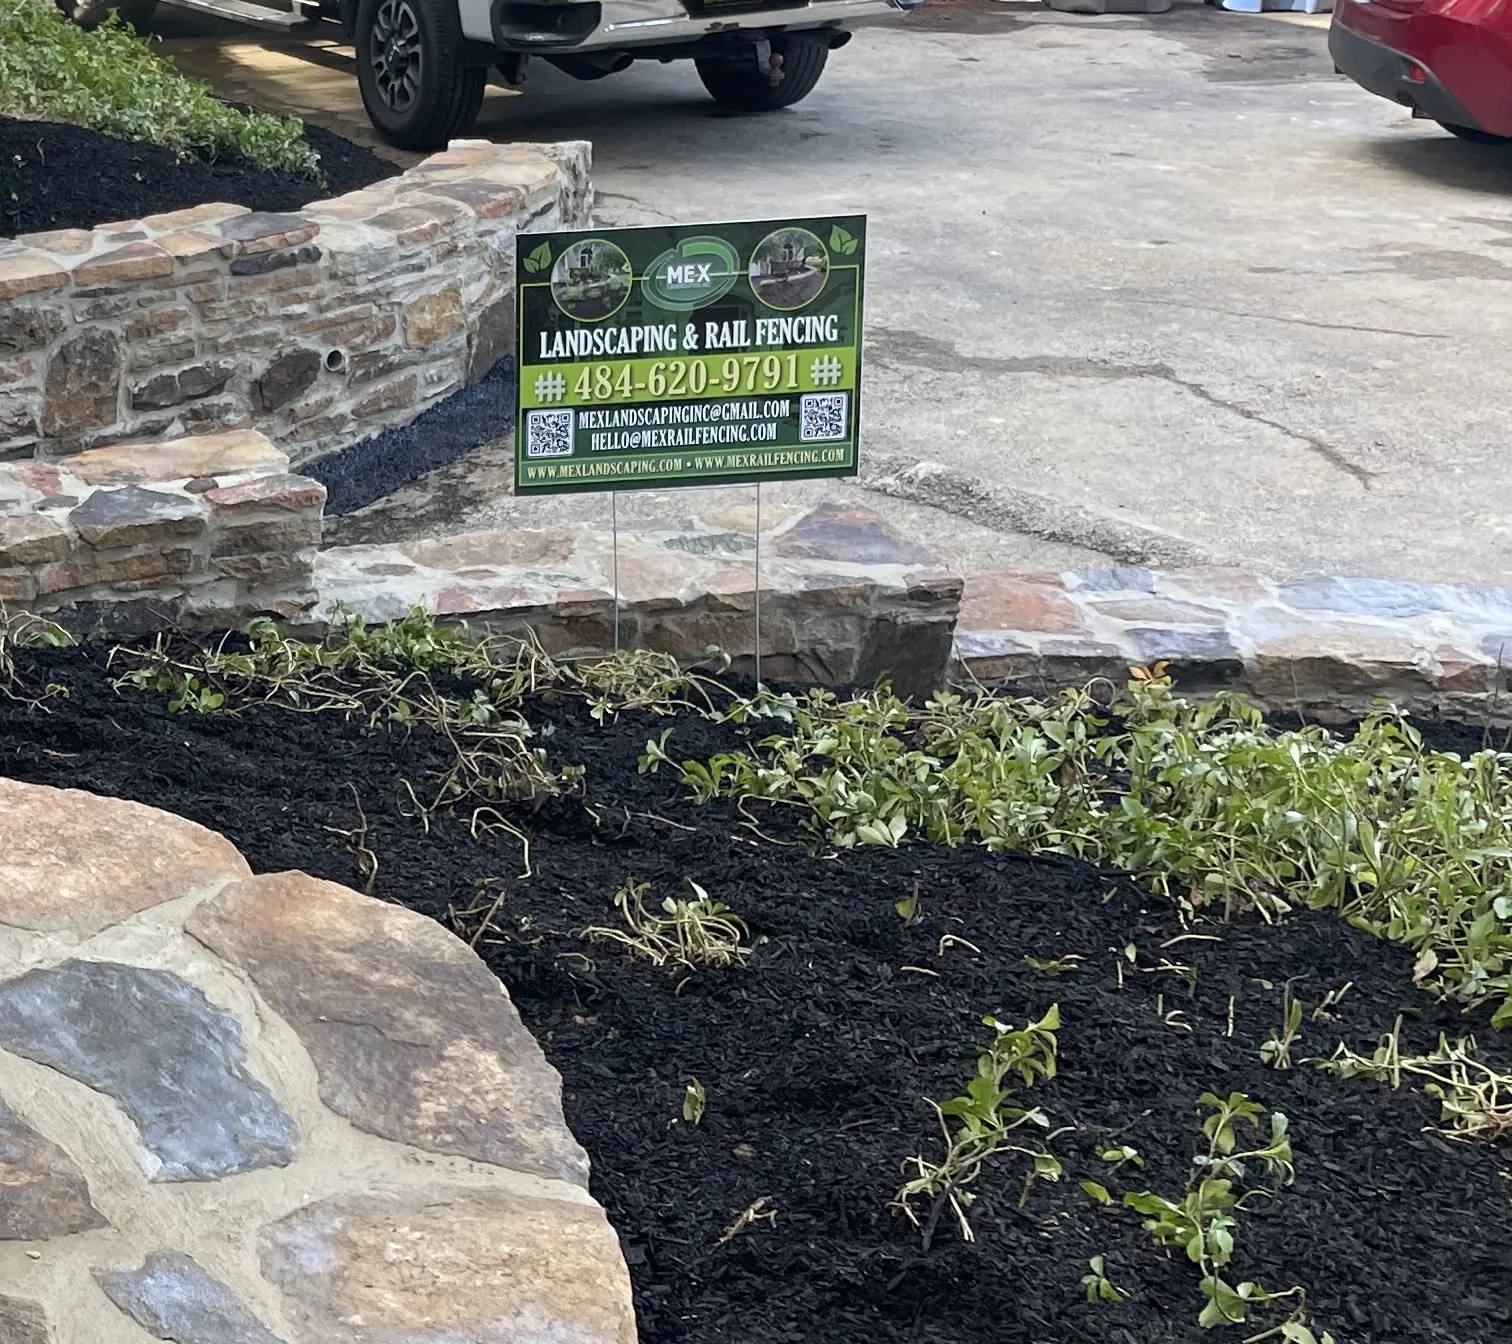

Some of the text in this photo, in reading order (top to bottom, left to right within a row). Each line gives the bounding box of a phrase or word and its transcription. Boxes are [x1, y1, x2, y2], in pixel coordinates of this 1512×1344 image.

[667, 263, 711, 285] MEX
[539, 314, 838, 358] LANDSCAPING & RAIL FENCING
[574, 354, 799, 400] 484-620-9791
[578, 399, 791, 429] MEXLANDSCAPINGINC@GMAIL.COM
[591, 422, 777, 451] HELLO@MEXRAILFENCING.COM
[527, 448, 845, 480] WWW.MEXLANDSCAPING.COM WWW.MEXRAILFENCING.COM
